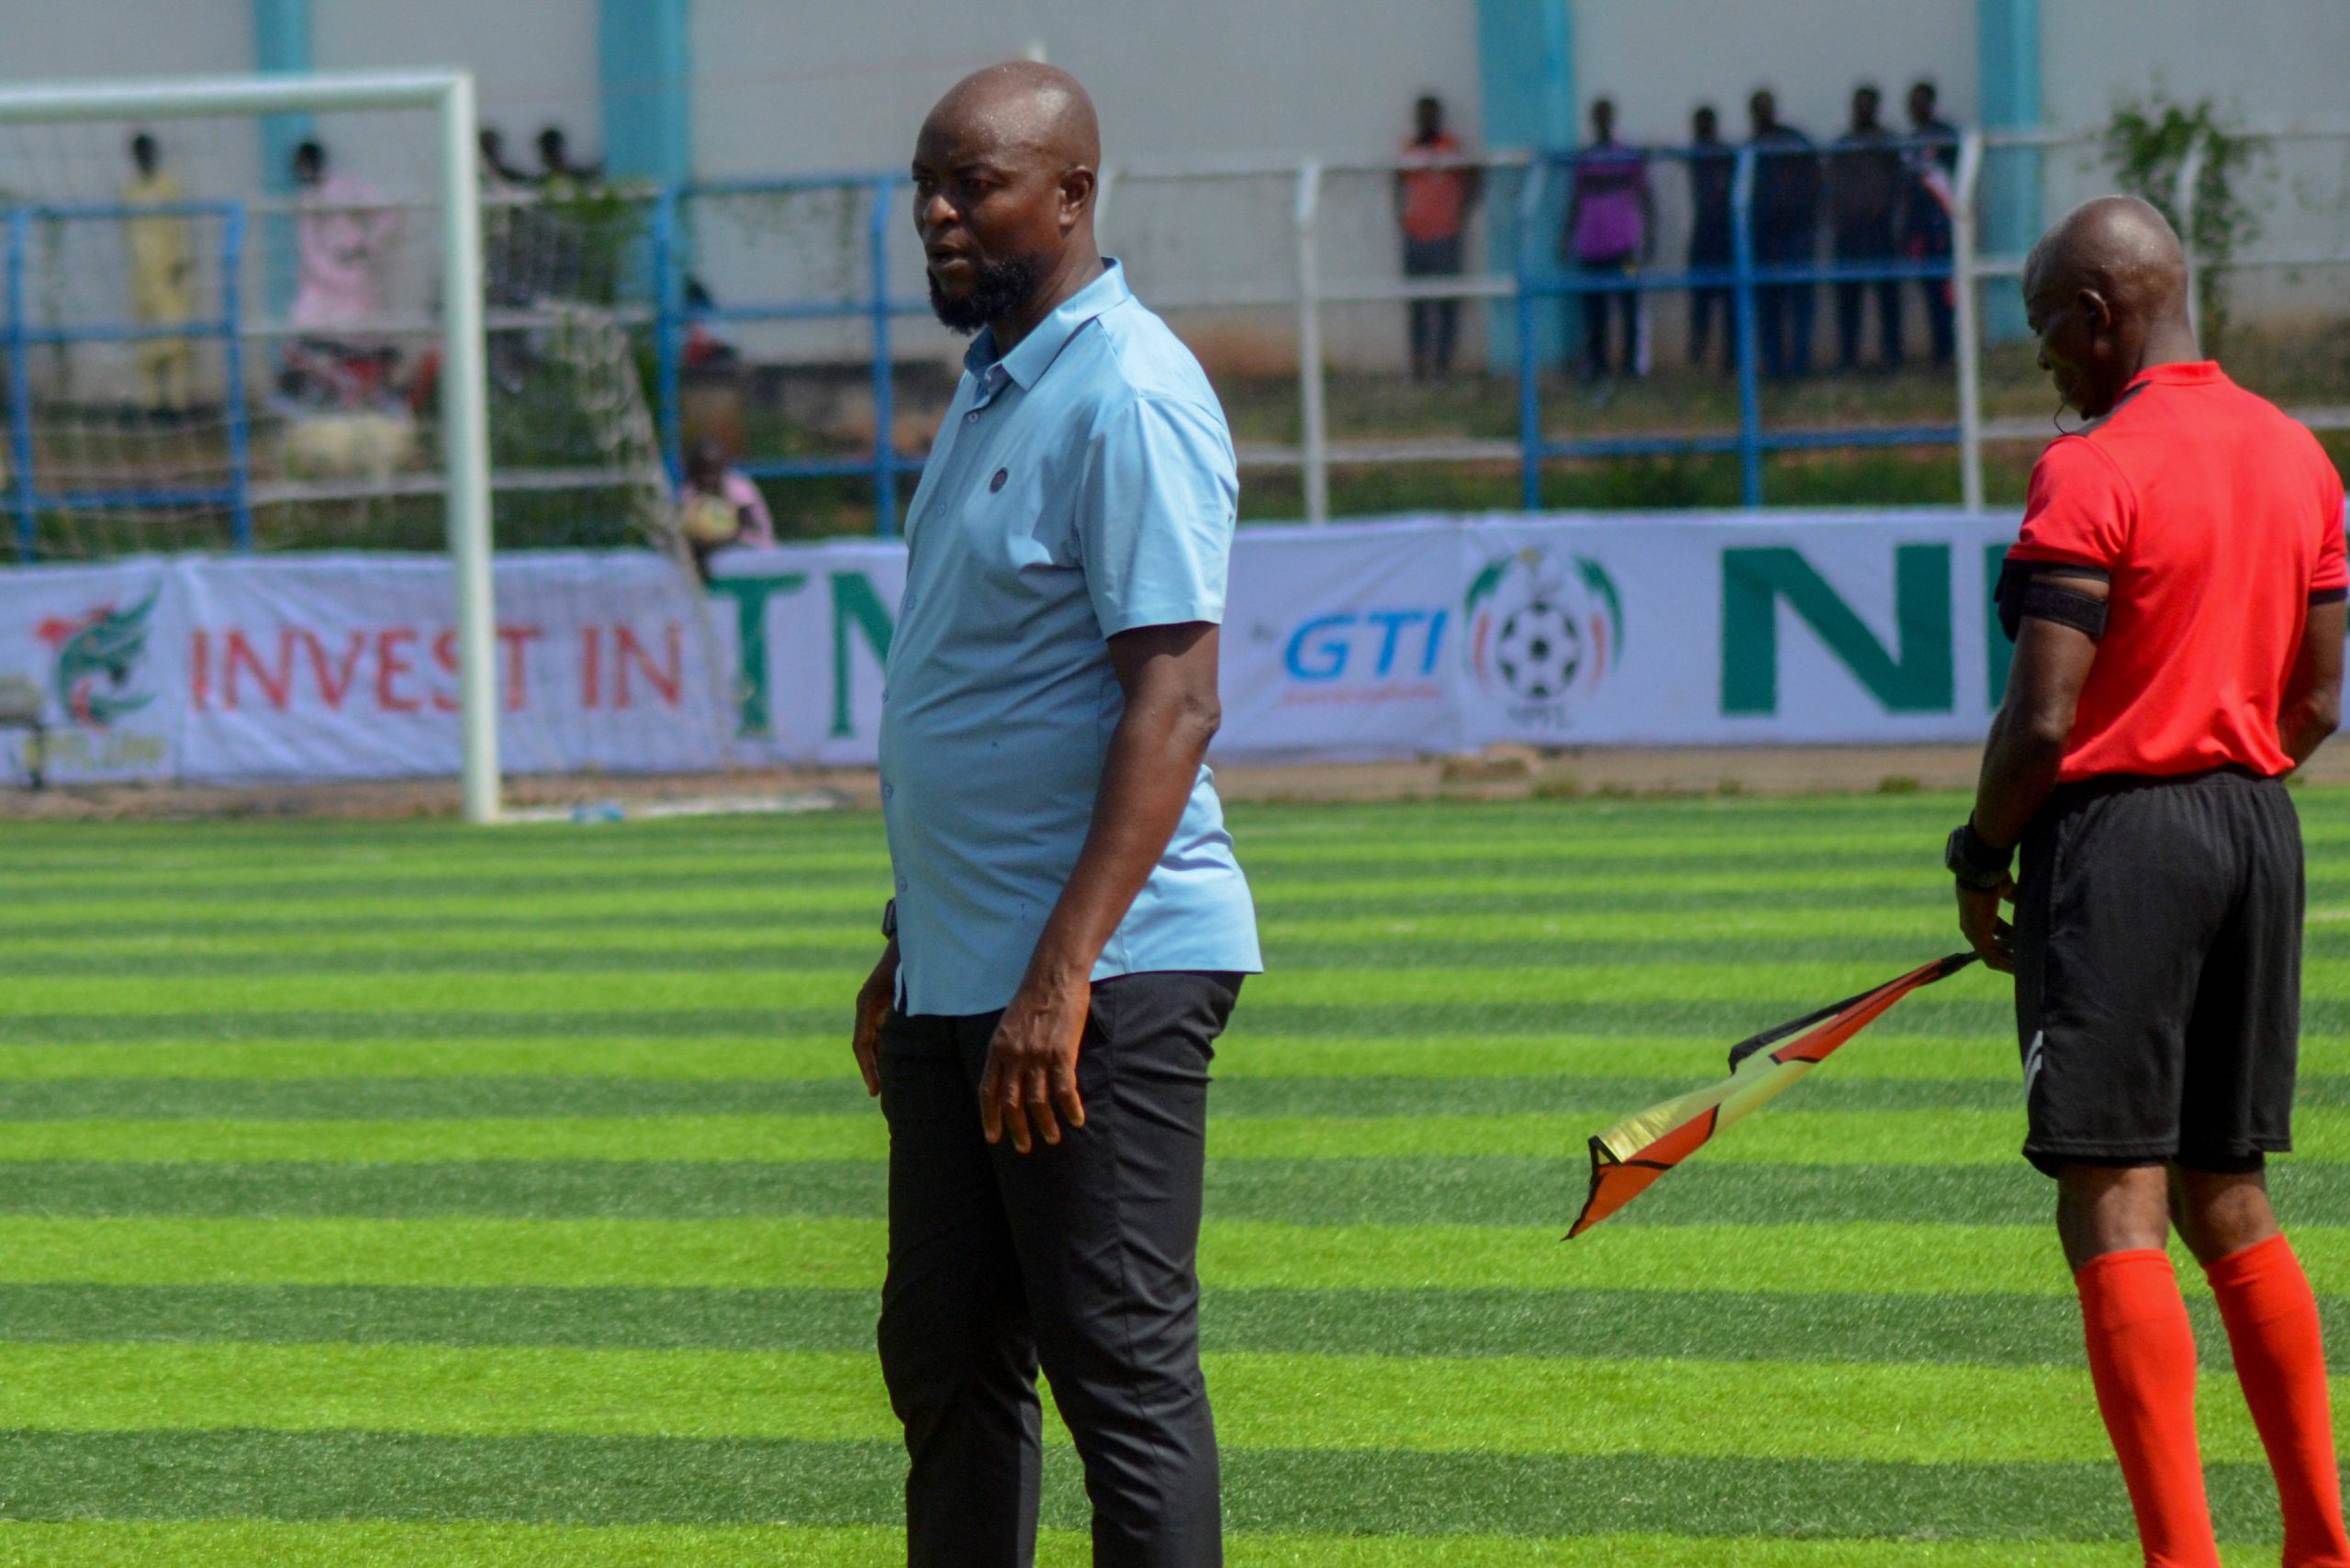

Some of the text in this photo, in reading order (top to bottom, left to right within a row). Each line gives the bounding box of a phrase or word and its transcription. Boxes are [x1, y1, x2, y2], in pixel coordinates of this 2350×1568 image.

[191, 622, 682, 712] INVEST IN
[1283, 609, 1449, 682] GTI
